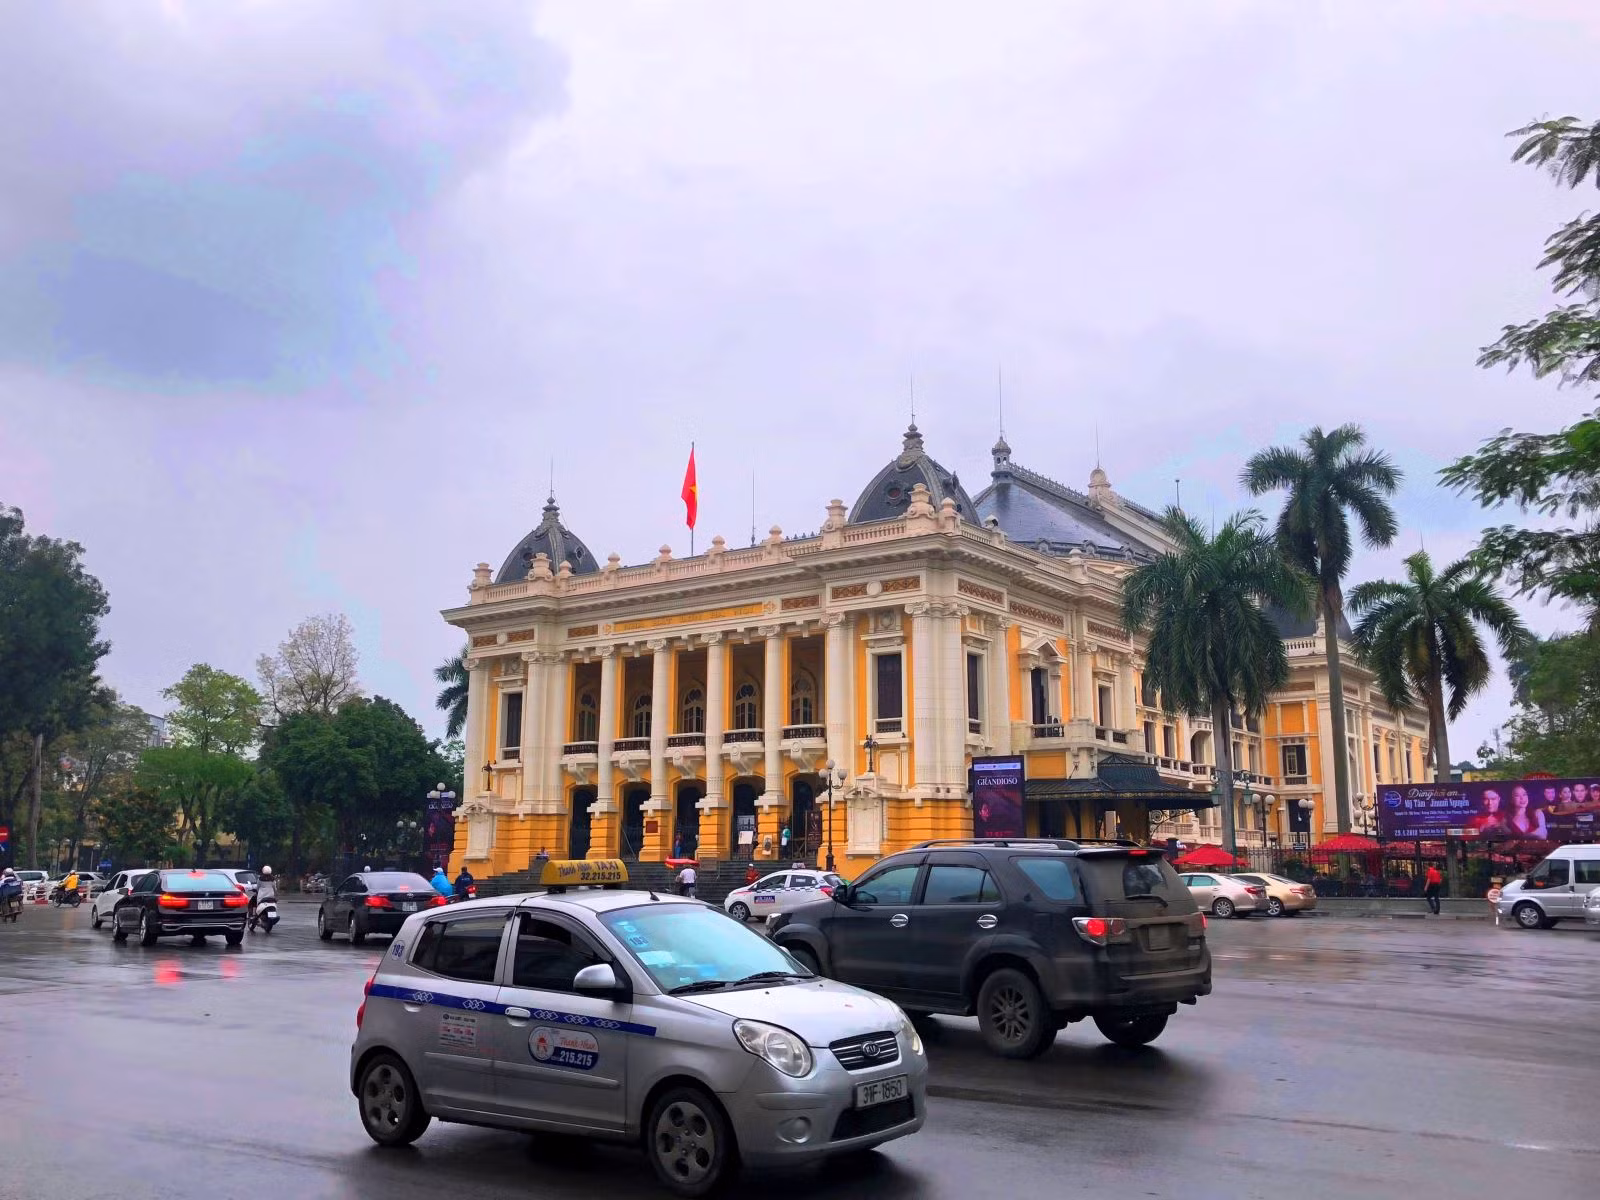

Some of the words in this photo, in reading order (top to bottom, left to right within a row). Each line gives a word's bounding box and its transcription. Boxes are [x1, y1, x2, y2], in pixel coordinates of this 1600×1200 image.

[977, 777, 1018, 786] GRANDIOSO
[593, 861, 619, 871] TAXI
[580, 871, 621, 881] 32.215.215
[560, 1050, 593, 1067] 215.215
